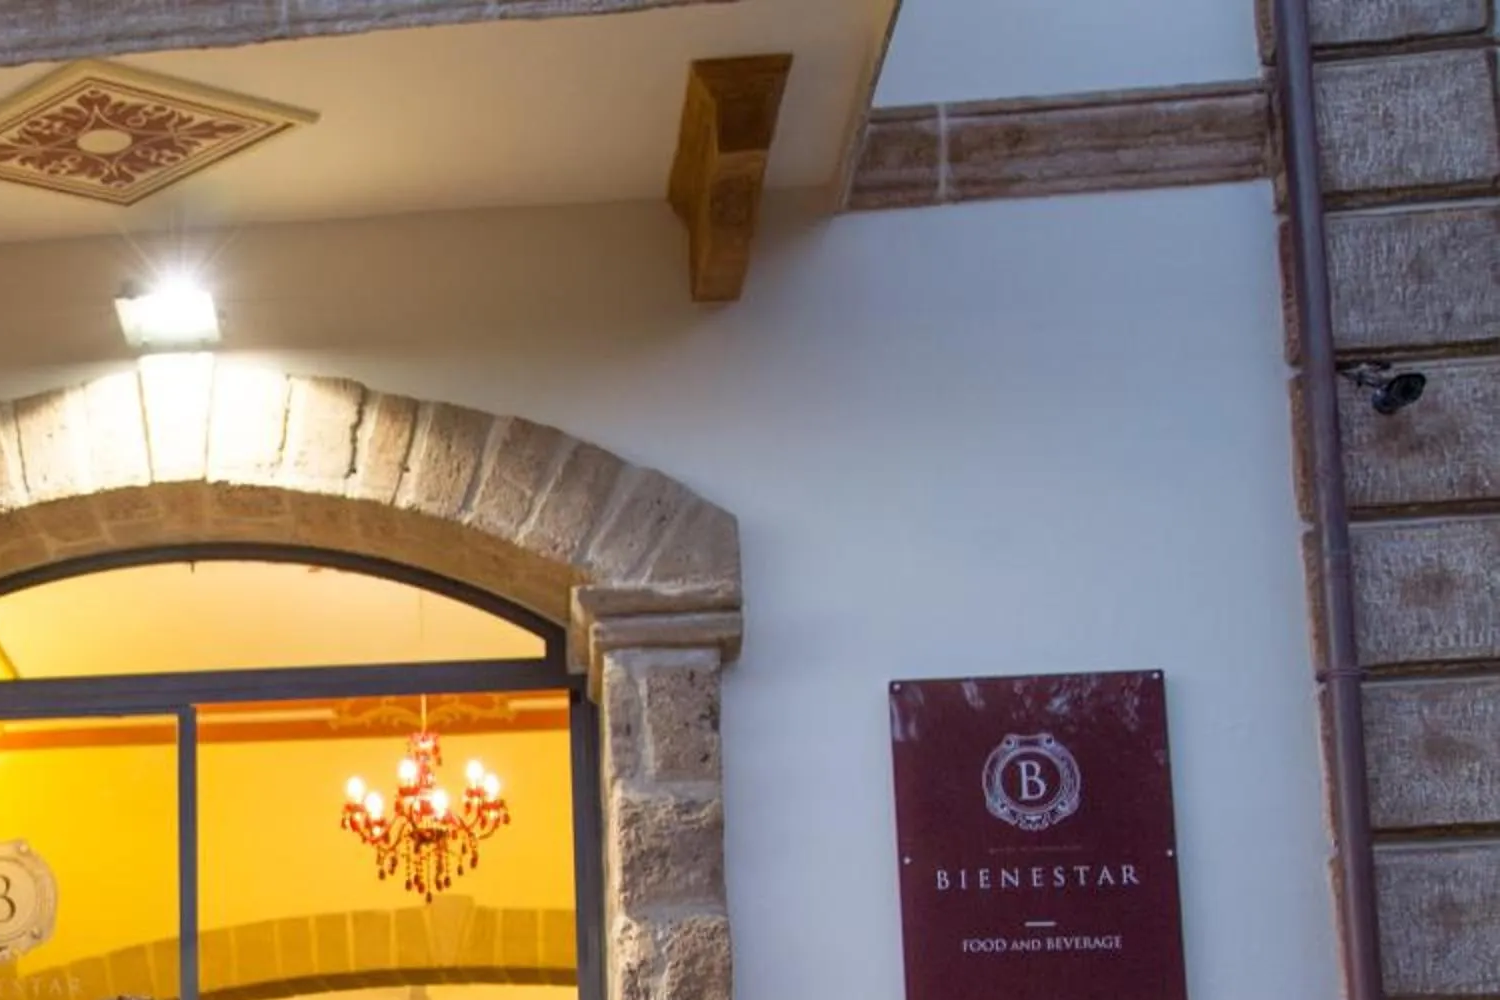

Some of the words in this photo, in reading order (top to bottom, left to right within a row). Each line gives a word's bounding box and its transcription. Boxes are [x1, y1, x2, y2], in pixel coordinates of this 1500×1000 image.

[1017, 759, 1047, 801] B
[936, 864, 1140, 890] BIENESTAR
[963, 938, 1007, 952] FOOD
[1010, 938, 1041, 951] AND
[1046, 935, 1122, 950] BEVERAGE
